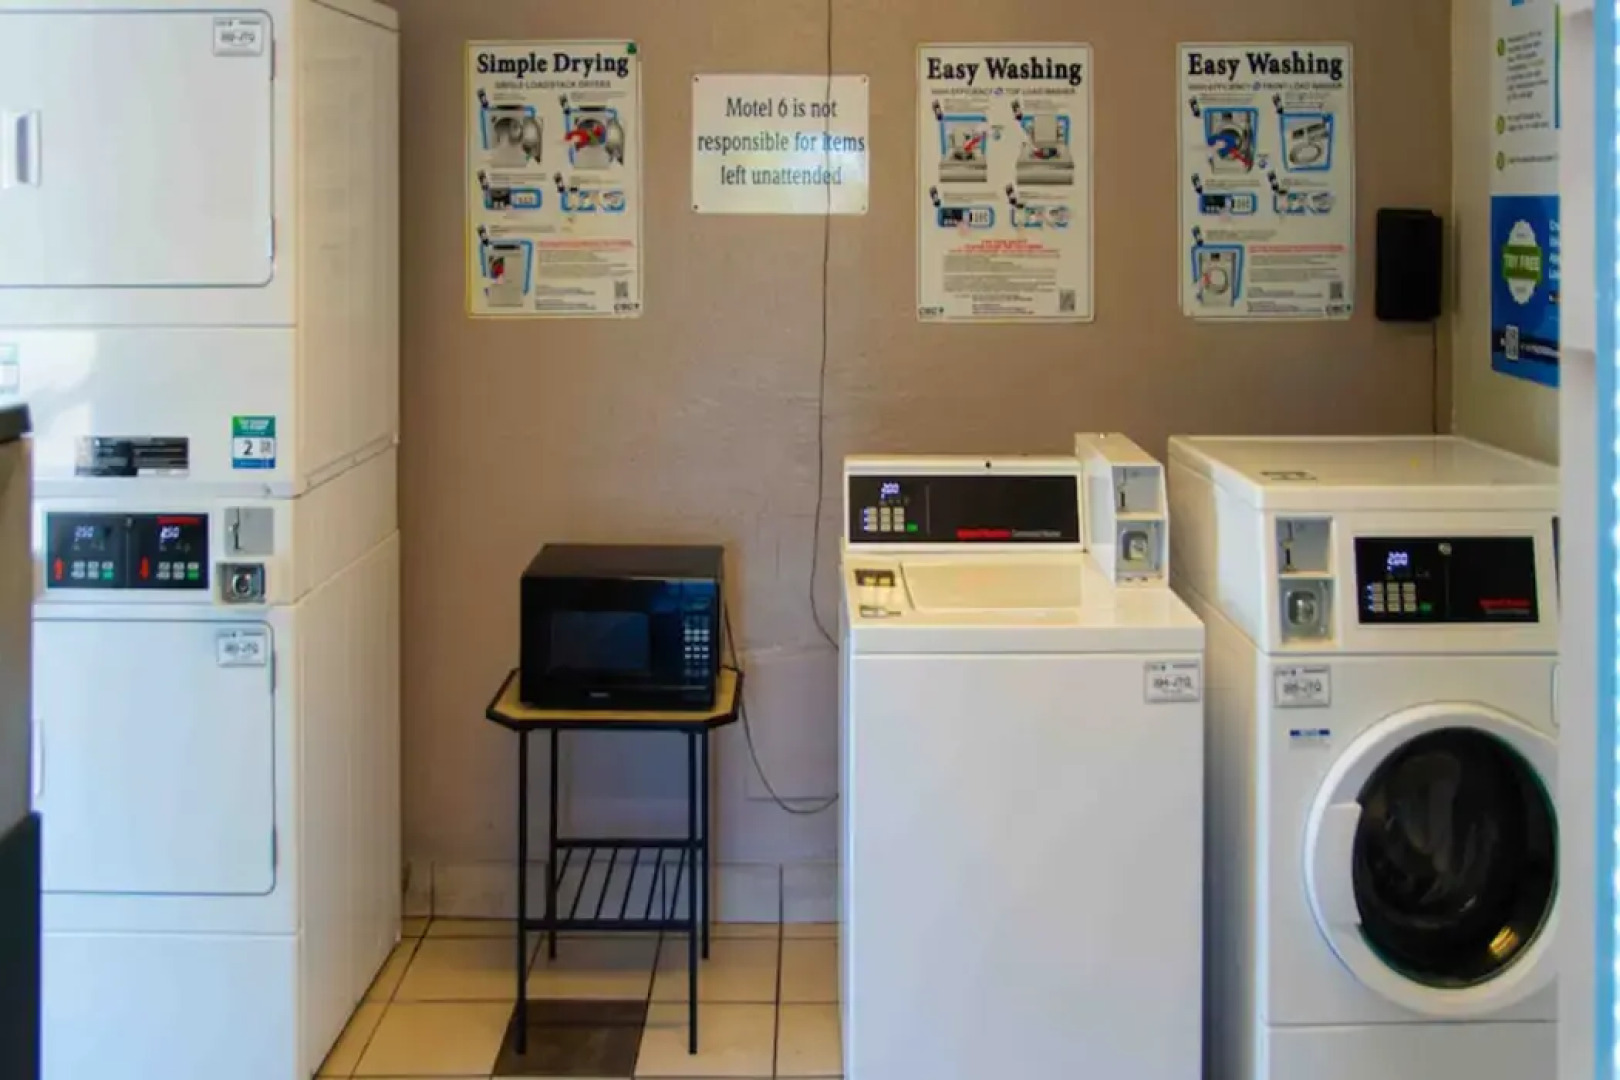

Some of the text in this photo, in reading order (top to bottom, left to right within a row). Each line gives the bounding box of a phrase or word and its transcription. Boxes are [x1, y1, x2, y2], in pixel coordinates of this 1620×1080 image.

[477, 52, 629, 78] Simple Drying
[927, 56, 1083, 86] Easy Washing
[1187, 51, 1343, 81] Easy Washing
[725, 97, 838, 117] Motel 6 is not
[697, 131, 865, 156] responsible for items
[720, 165, 842, 185] left unattended
[243, 439, 254, 456] 2
